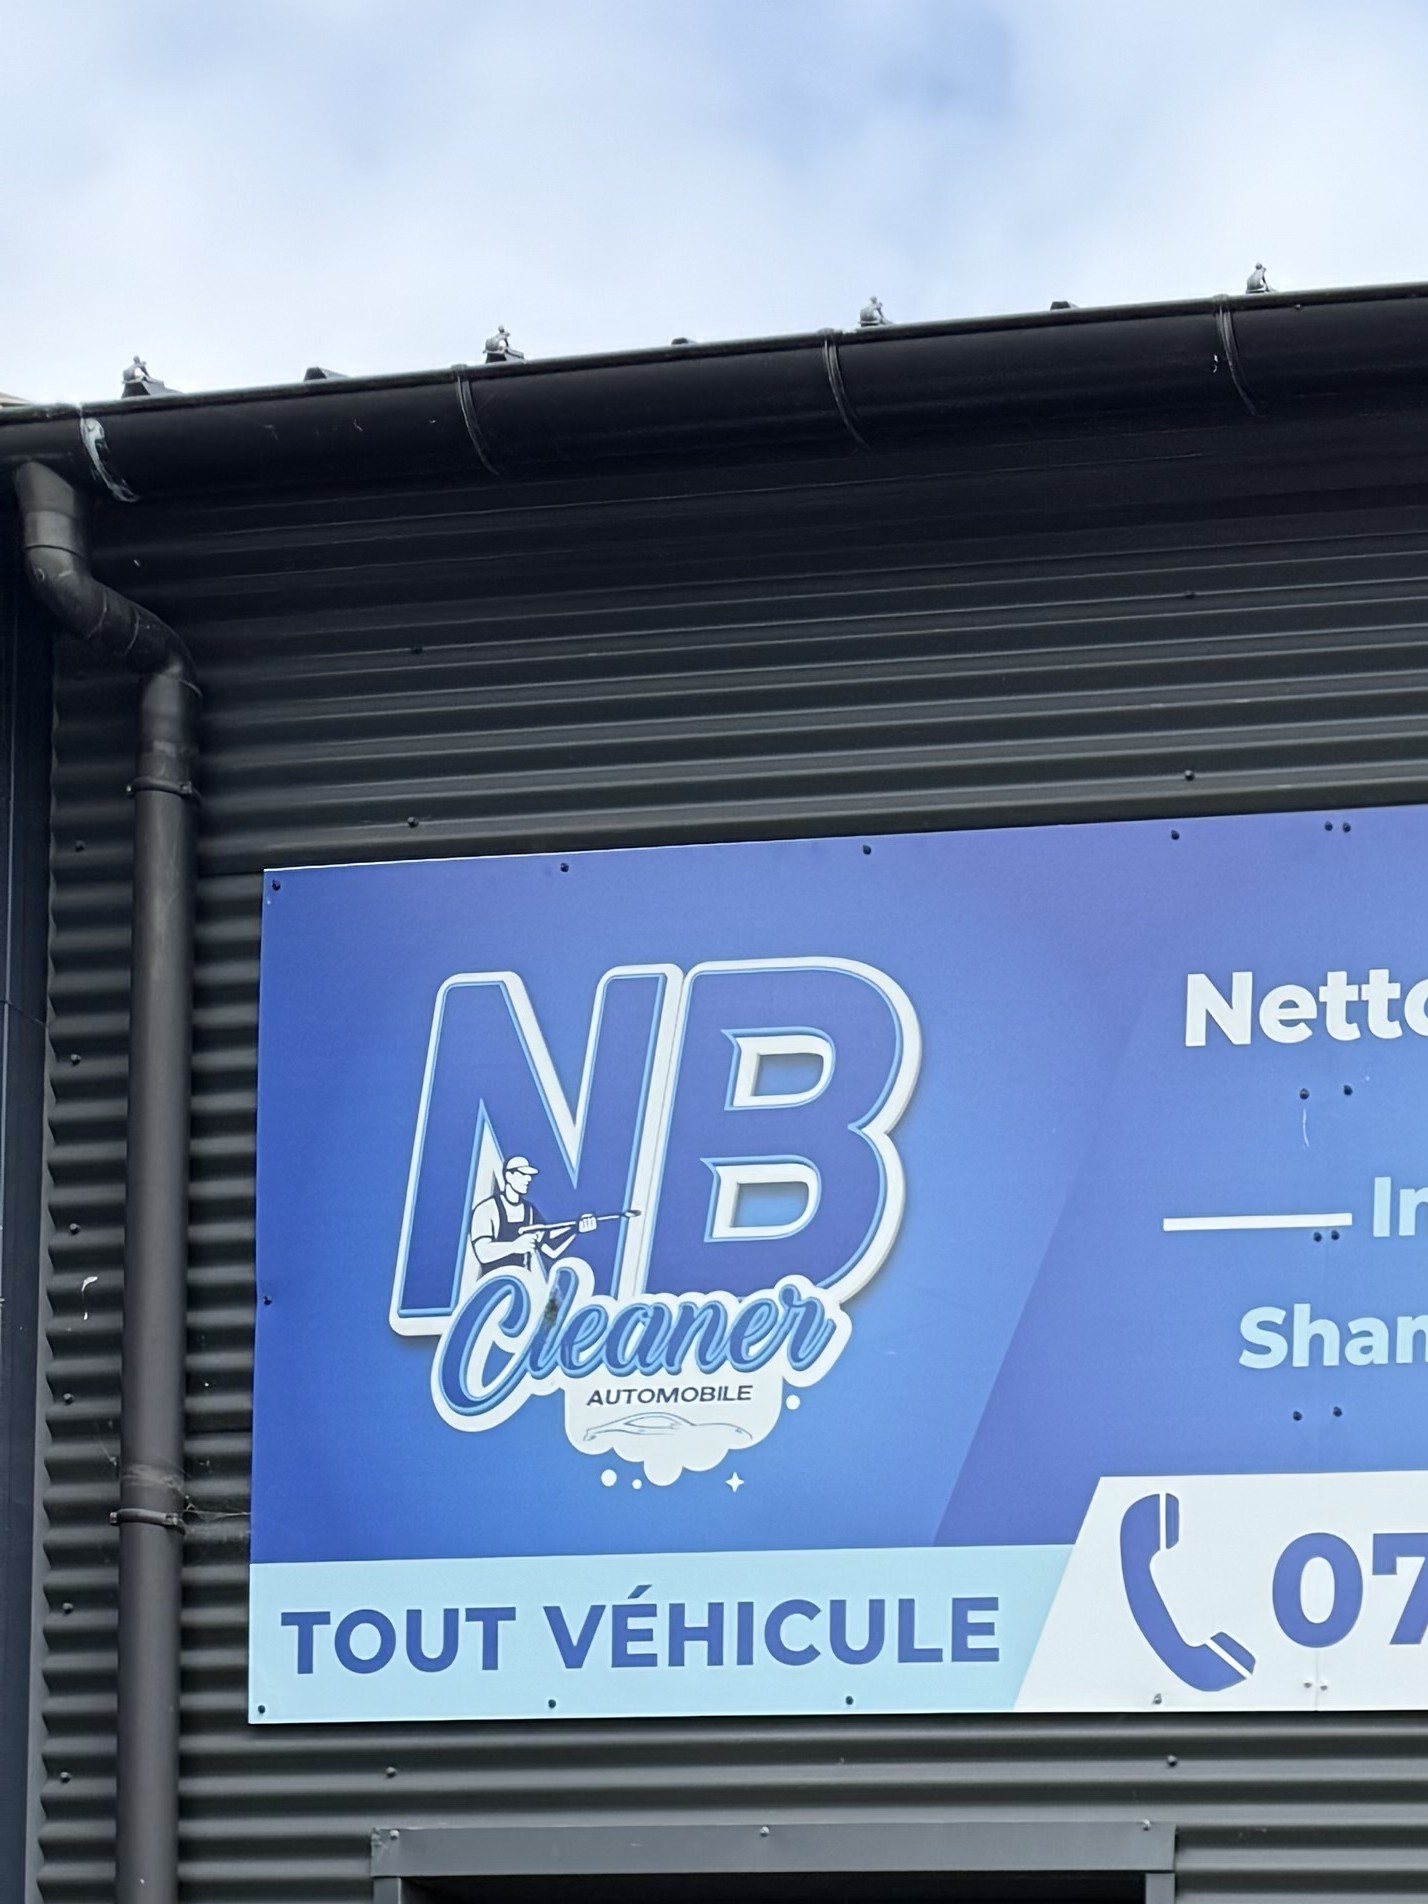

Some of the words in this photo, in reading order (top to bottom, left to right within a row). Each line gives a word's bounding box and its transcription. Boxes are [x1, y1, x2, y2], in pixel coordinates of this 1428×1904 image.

[390, 956, 923, 1336] NB
[437, 1258, 838, 1418] Cleaner
[586, 1383, 753, 1408] AUTOMOBILE
[281, 1604, 517, 1676] TOUT
[544, 1585, 1001, 1671] VÉHICULE
